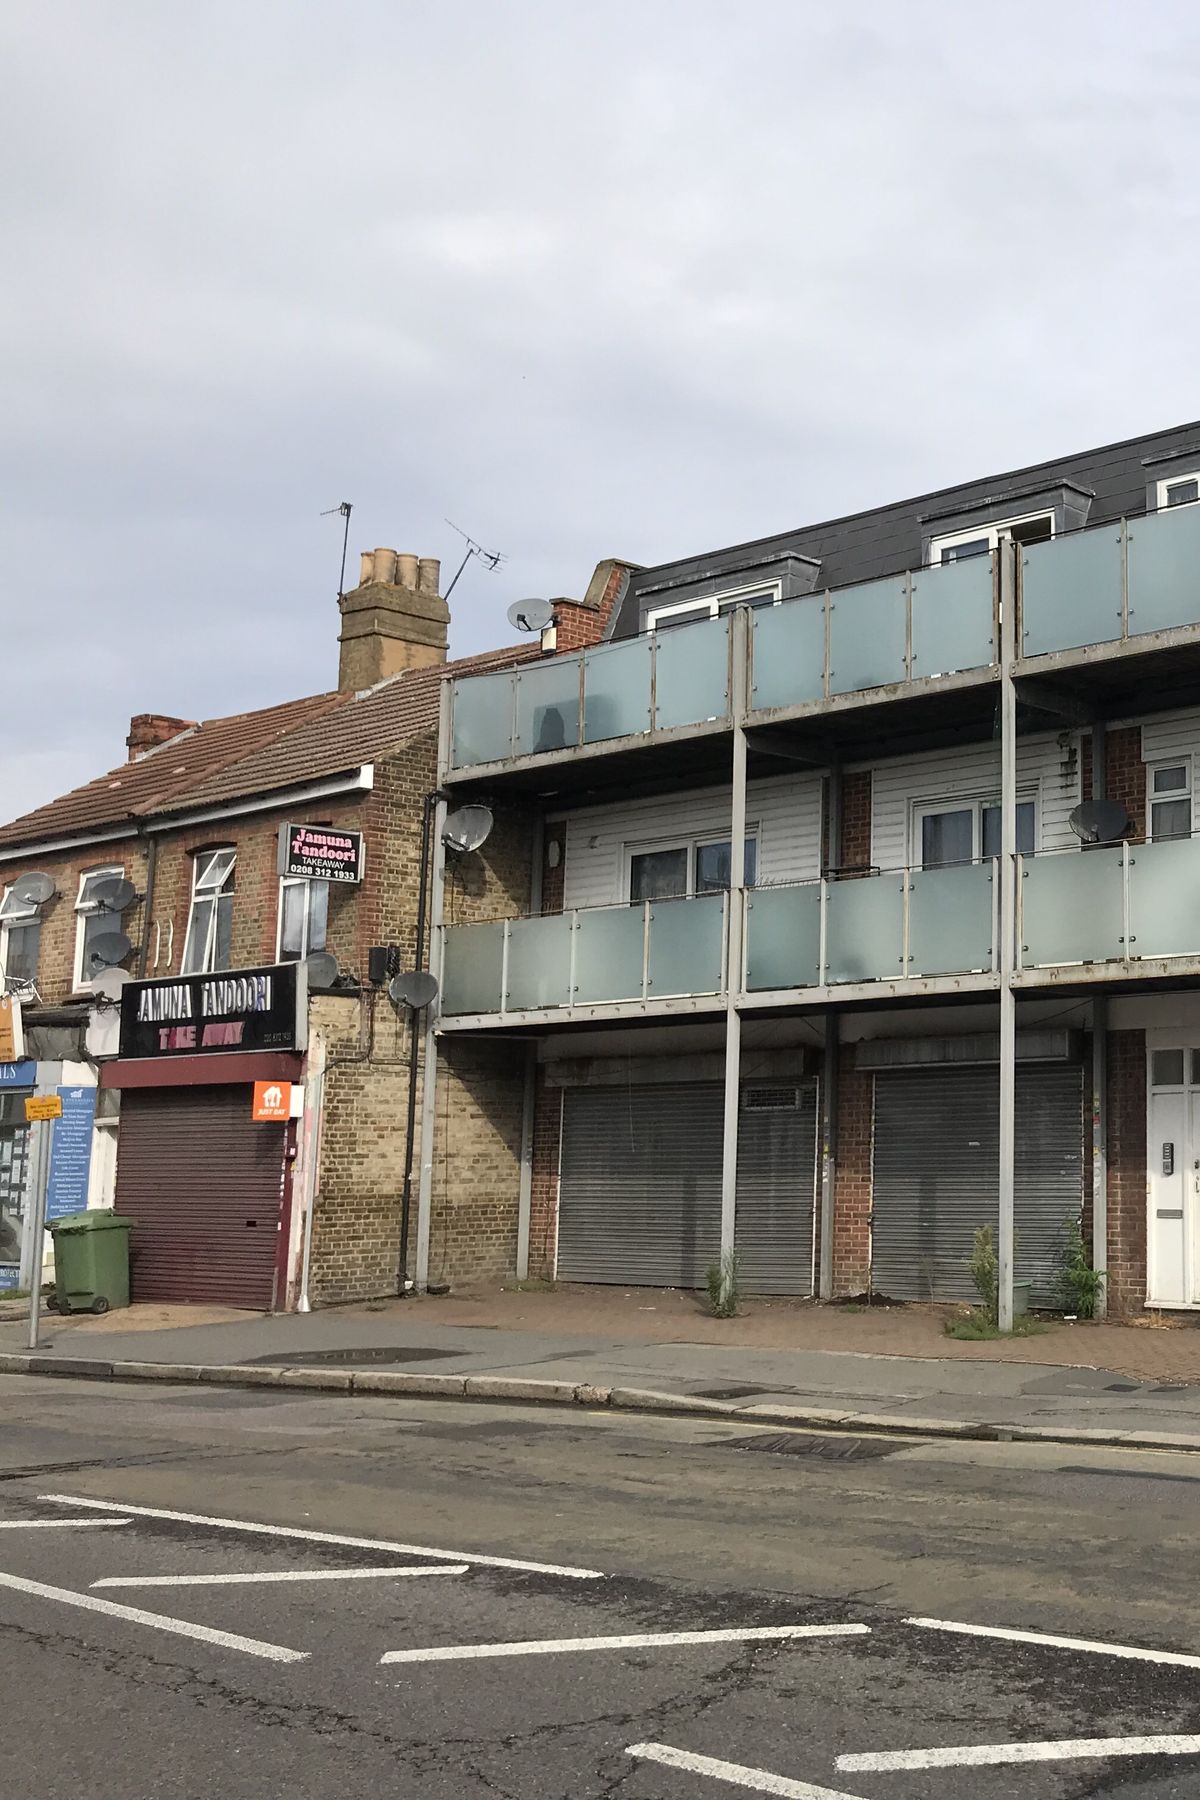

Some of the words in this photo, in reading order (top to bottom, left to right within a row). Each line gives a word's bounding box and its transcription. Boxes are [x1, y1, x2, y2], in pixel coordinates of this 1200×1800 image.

[296, 829, 352, 848] Jamuna
[291, 841, 356, 862] Tandoori
[290, 864, 313, 875] 0208
[315, 868, 332, 877] 312
[333, 870, 355, 880] 1933
[302, 857, 345, 870] TAKEAWAY
[137, 984, 193, 1021] JAMUNA
[201, 976, 272, 1017] TANDOORI
[159, 1025, 197, 1050] TAKE
[201, 1021, 245, 1047] AWAY
[257, 1108, 273, 1116] JUST
[273, 1108, 286, 1116] EAT
